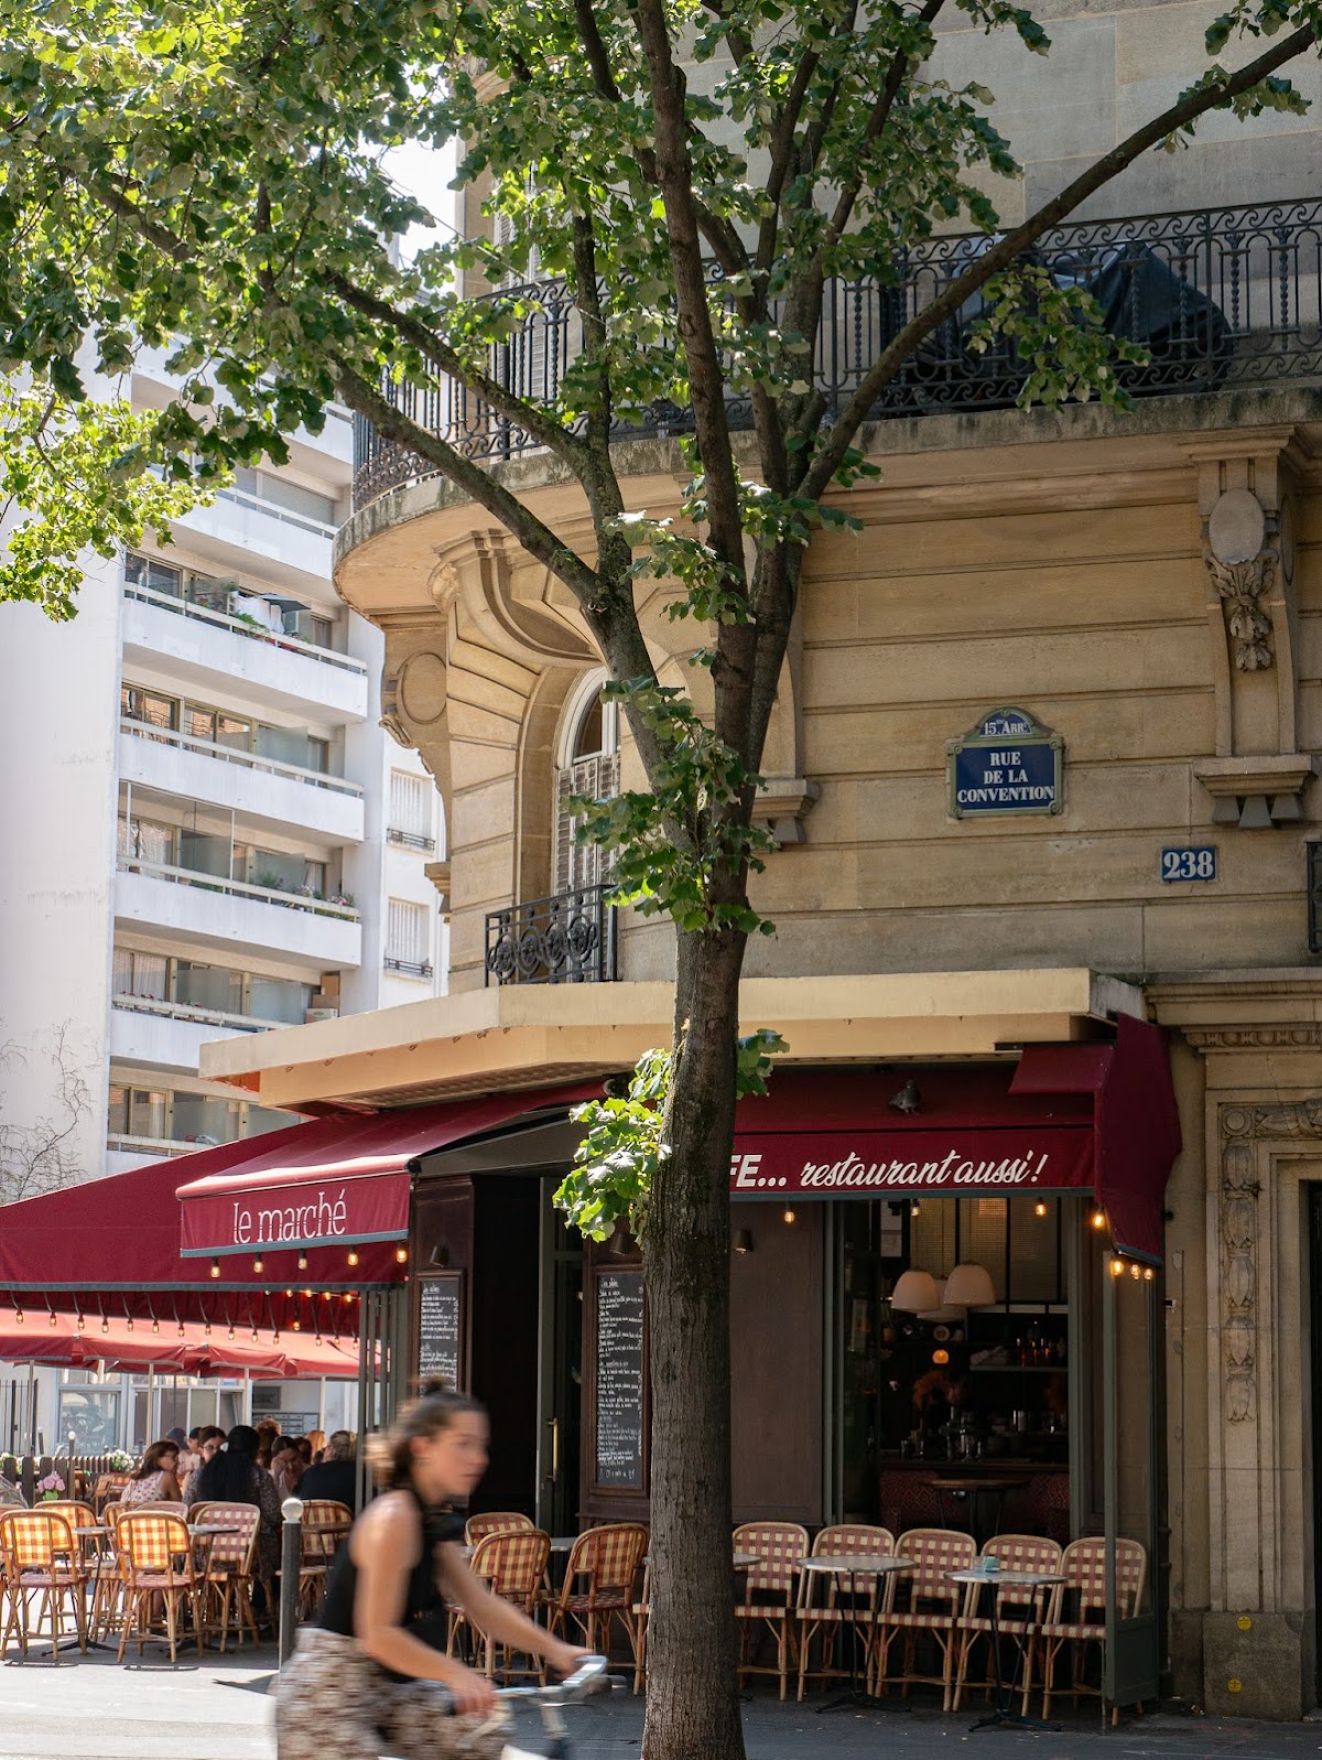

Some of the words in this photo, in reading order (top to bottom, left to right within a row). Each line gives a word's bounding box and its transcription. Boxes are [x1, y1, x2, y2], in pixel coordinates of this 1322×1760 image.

[990, 752, 1021, 766] RUE
[983, 770, 1003, 784] DE
[1008, 769, 1028, 783] LA
[957, 786, 1055, 803] CONVENTION
[1163, 850, 1214, 879] 238
[800, 1149, 961, 1187] restaurant
[233, 1202, 252, 1244] le
[257, 1188, 347, 1243] marché
